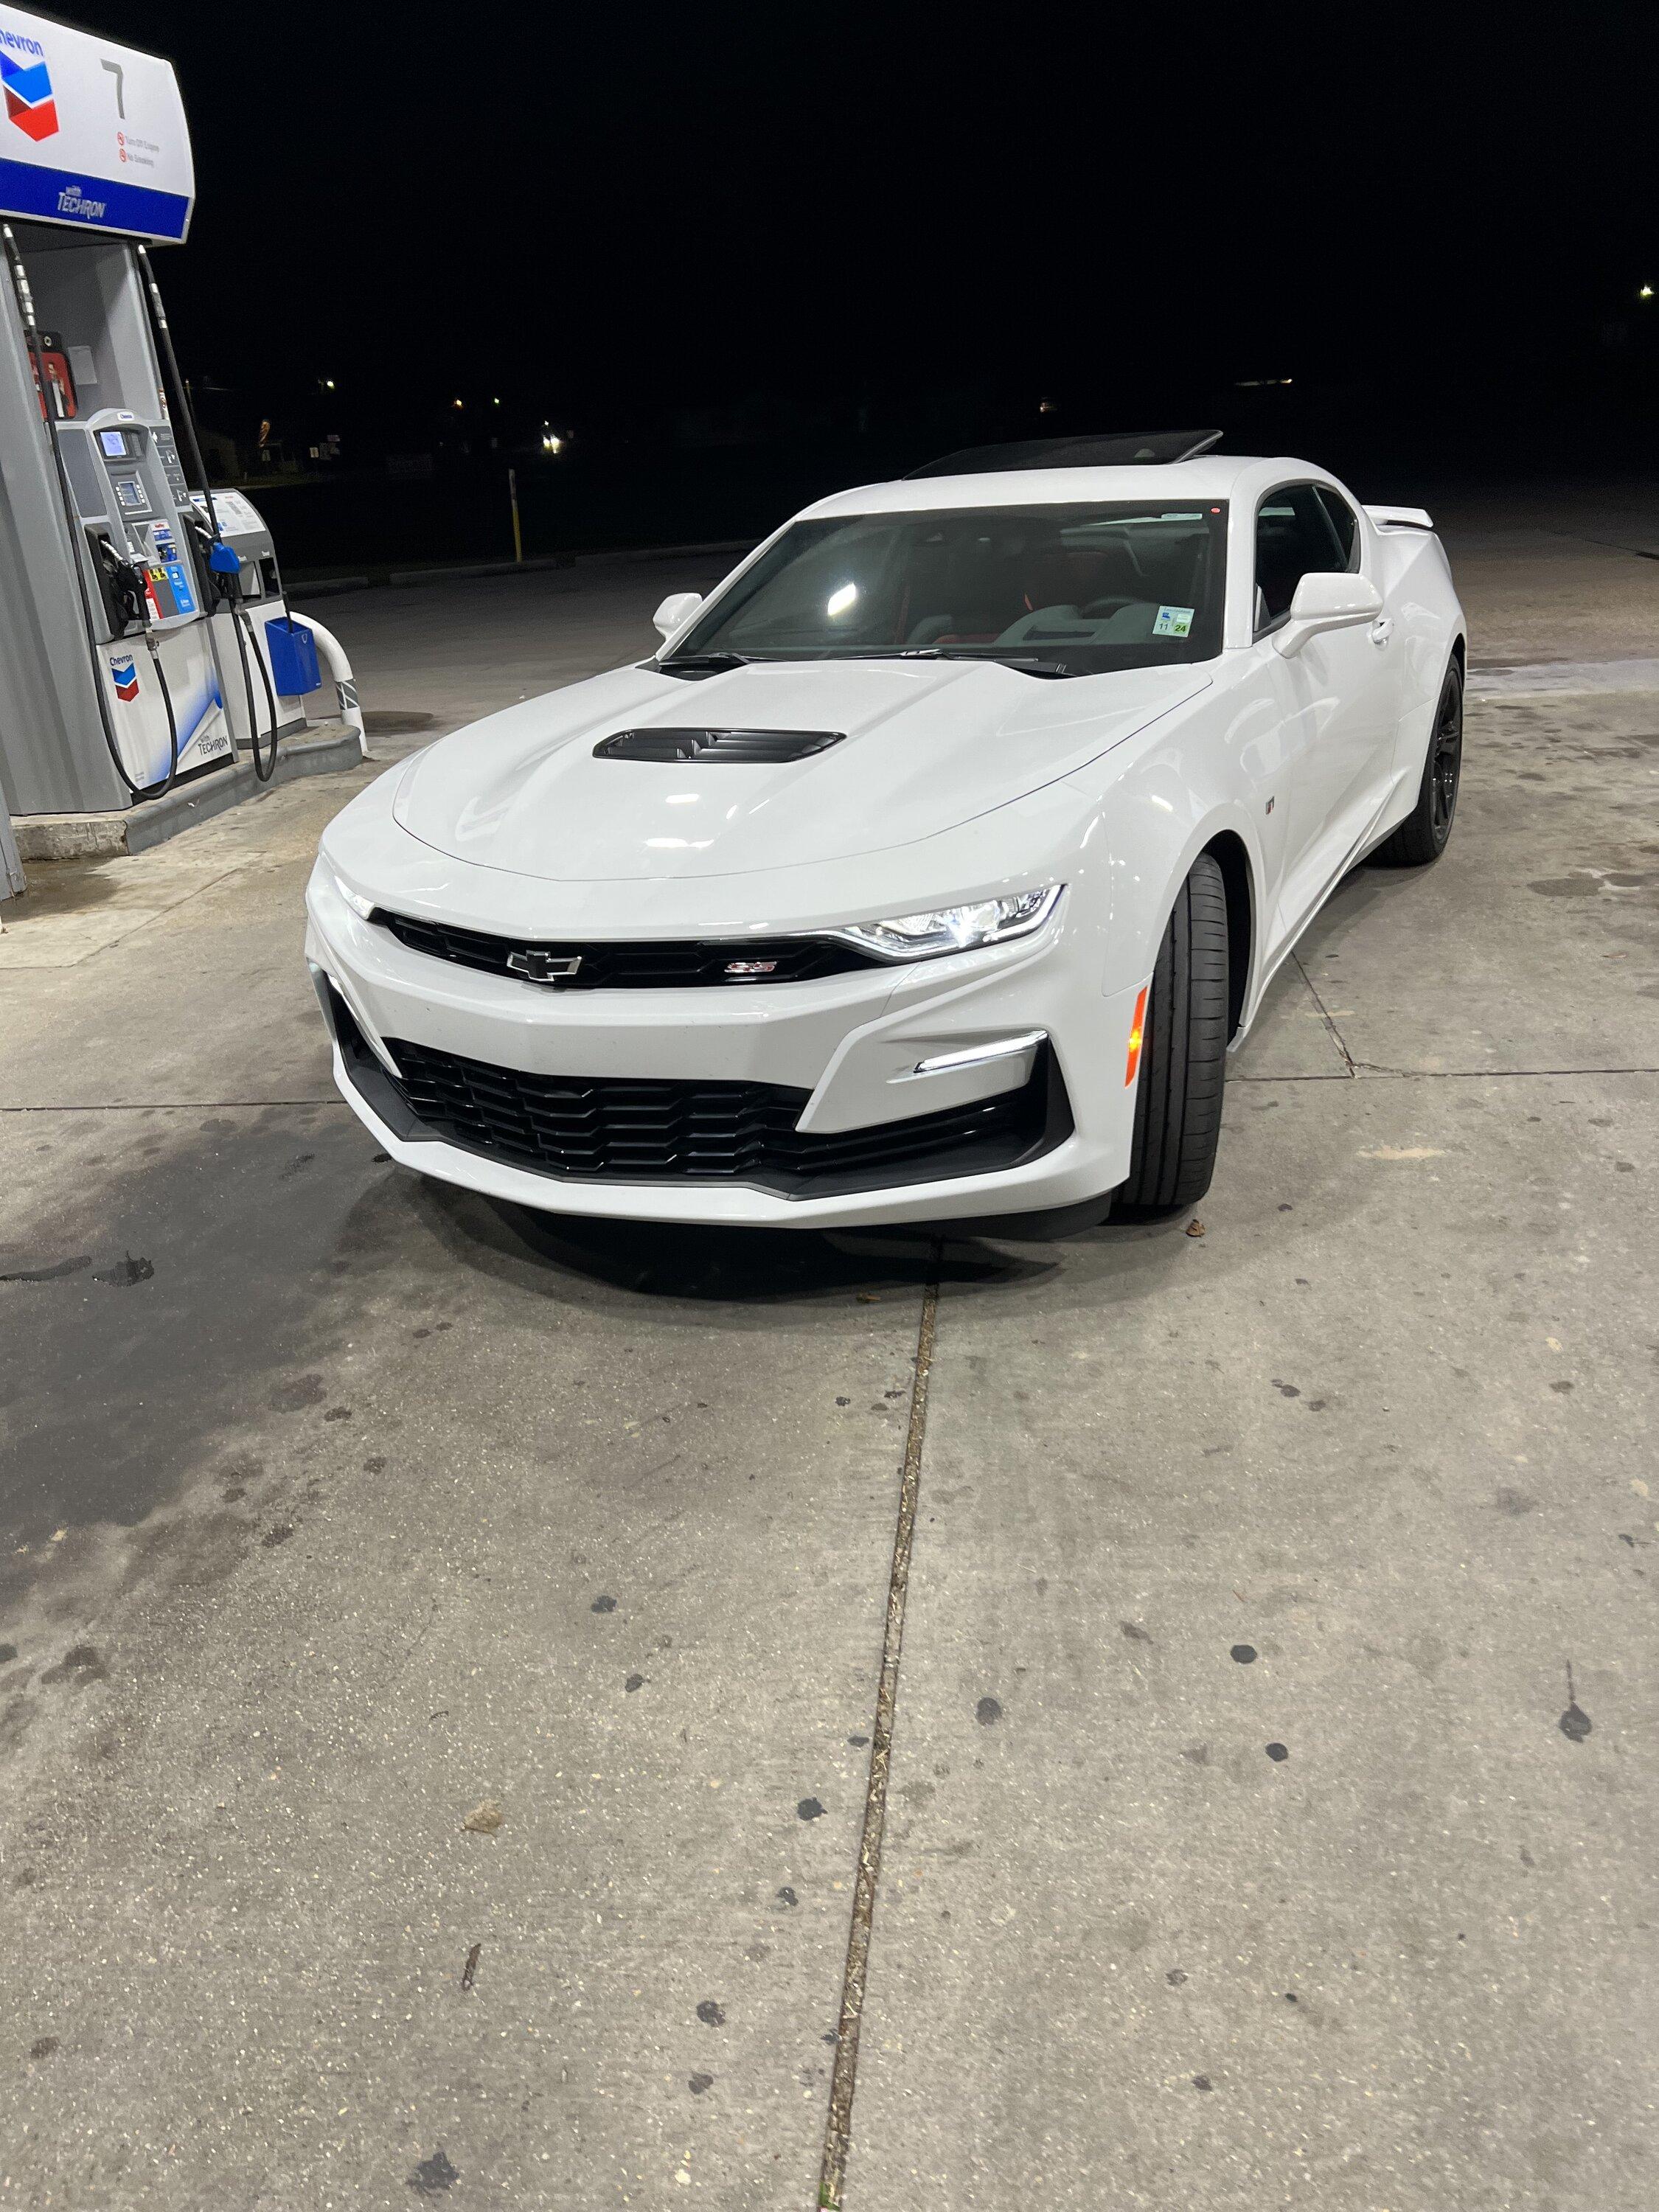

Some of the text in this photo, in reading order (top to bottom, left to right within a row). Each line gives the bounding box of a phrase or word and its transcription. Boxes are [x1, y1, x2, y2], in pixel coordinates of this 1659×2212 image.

[0, 29, 44, 57] hevron
[100, 58, 125, 119] 7
[58, 192, 107, 219] TECHRON
[110, 654, 133, 666] Chevron
[198, 736, 229, 755] TECHRON
